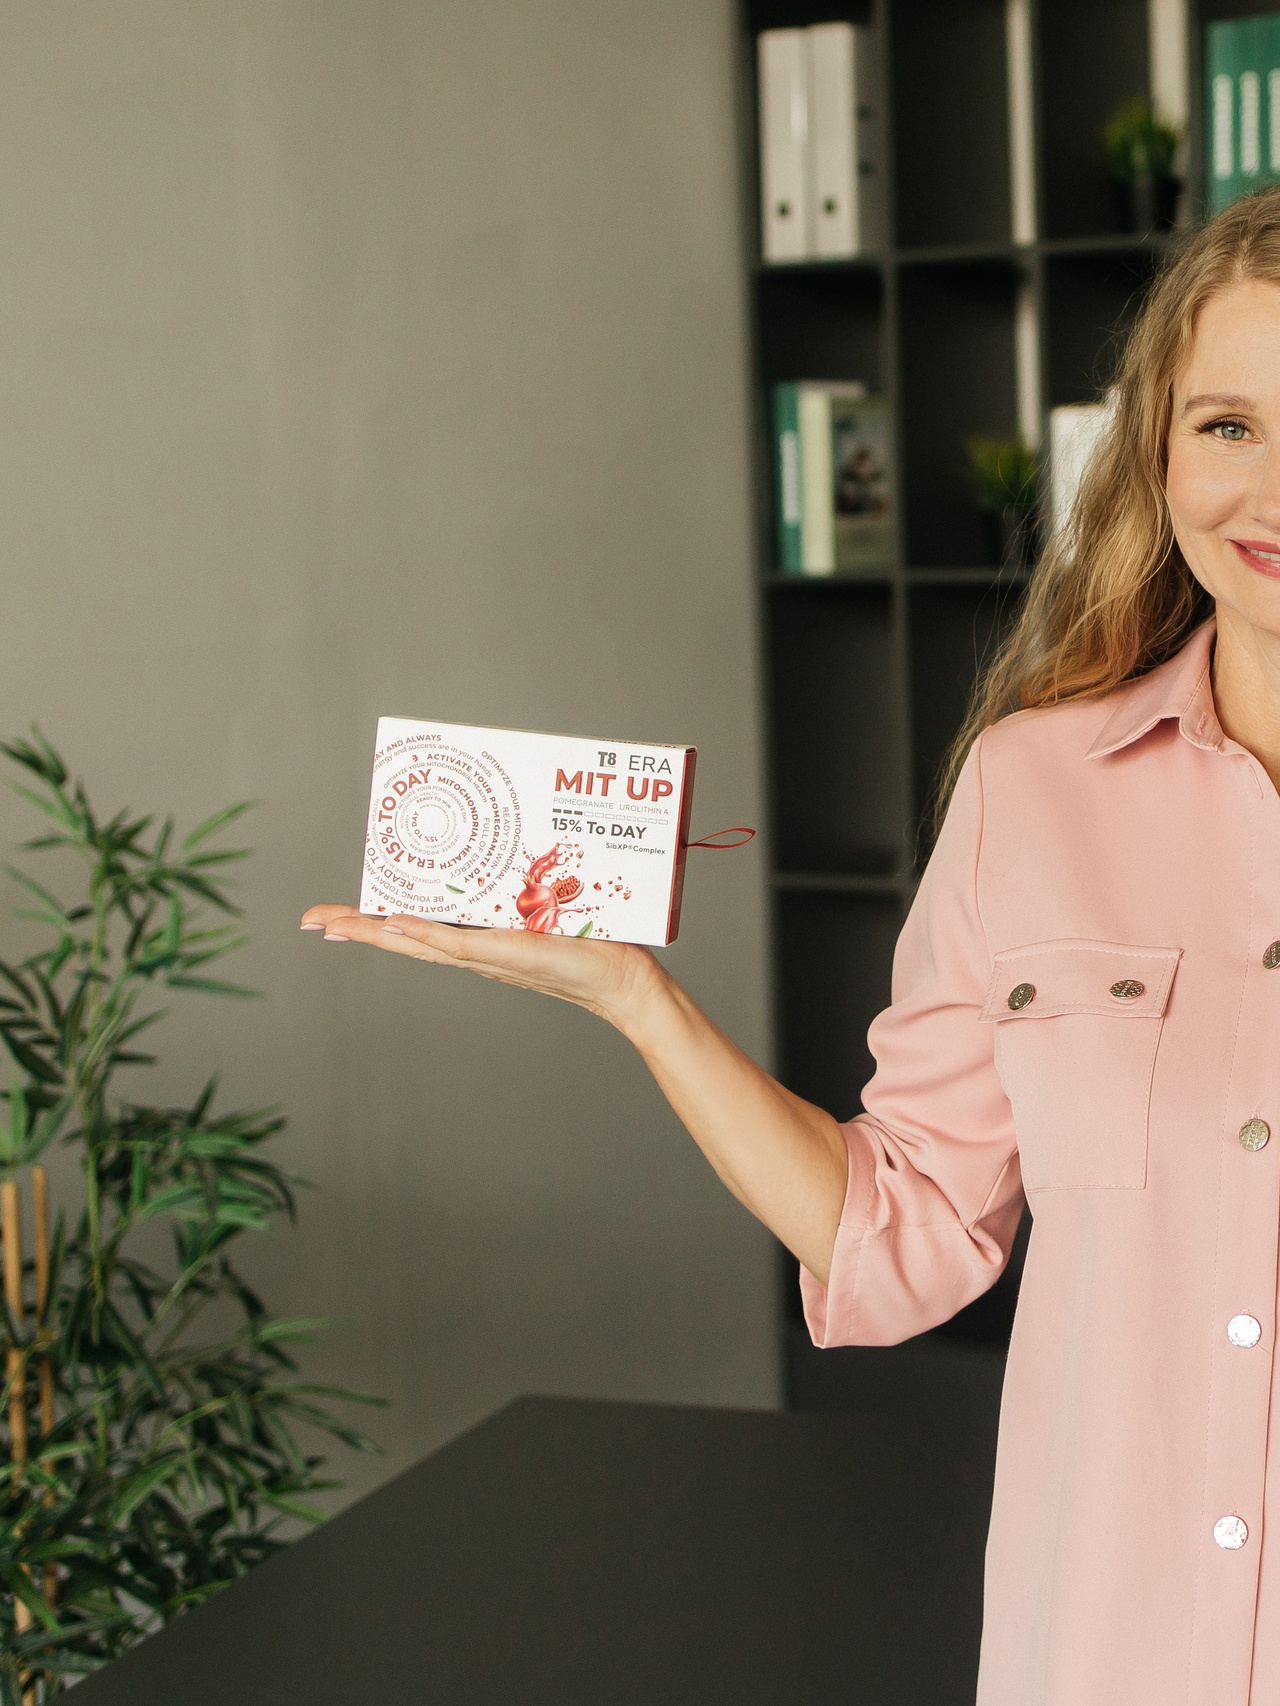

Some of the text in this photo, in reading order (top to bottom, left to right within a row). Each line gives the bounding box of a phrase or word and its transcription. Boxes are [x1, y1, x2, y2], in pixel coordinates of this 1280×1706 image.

[386, 740, 403, 752] AND
[406, 735, 441, 744] ALWAYS
[394, 747, 407, 757] and
[451, 745, 458, 753] in
[459, 750, 474, 760] your
[474, 758, 492, 777] hands
[598, 751, 672, 774] T8 ERA
[383, 762, 487, 803] OPTIMYZE YOUR MITOCHONDRIAL HEALTH
[392, 768, 431, 796] DAY
[555, 768, 673, 802] MIT UP
[378, 796, 396, 822] TO
[411, 811, 419, 827] DAY
[427, 753, 500, 883] ACTIVATE YOUR POMEGRANATE DAY
[553, 797, 614, 810] POMEGRANATE
[620, 804, 662, 815] UROLITHIN
[414, 829, 422, 839] TO
[437, 776, 479, 869] MITOCHONDRIAL HEALTH
[468, 751, 521, 904] OPTIMYZE YOUR MITOCHONDRIAL HEALTH
[552, 818, 647, 839] 15% To DAY
[379, 827, 405, 862] 15%
[451, 817, 490, 878] FULL OF ENERGY
[490, 806, 510, 869] READY TO WIN
[363, 858, 376, 875] AND
[367, 848, 414, 890] READY TO
[407, 853, 434, 868] ERA
[371, 882, 457, 912] UPDATE PROGRAM.
[375, 876, 399, 895] TODAY
[401, 891, 430, 902] YOUNG
